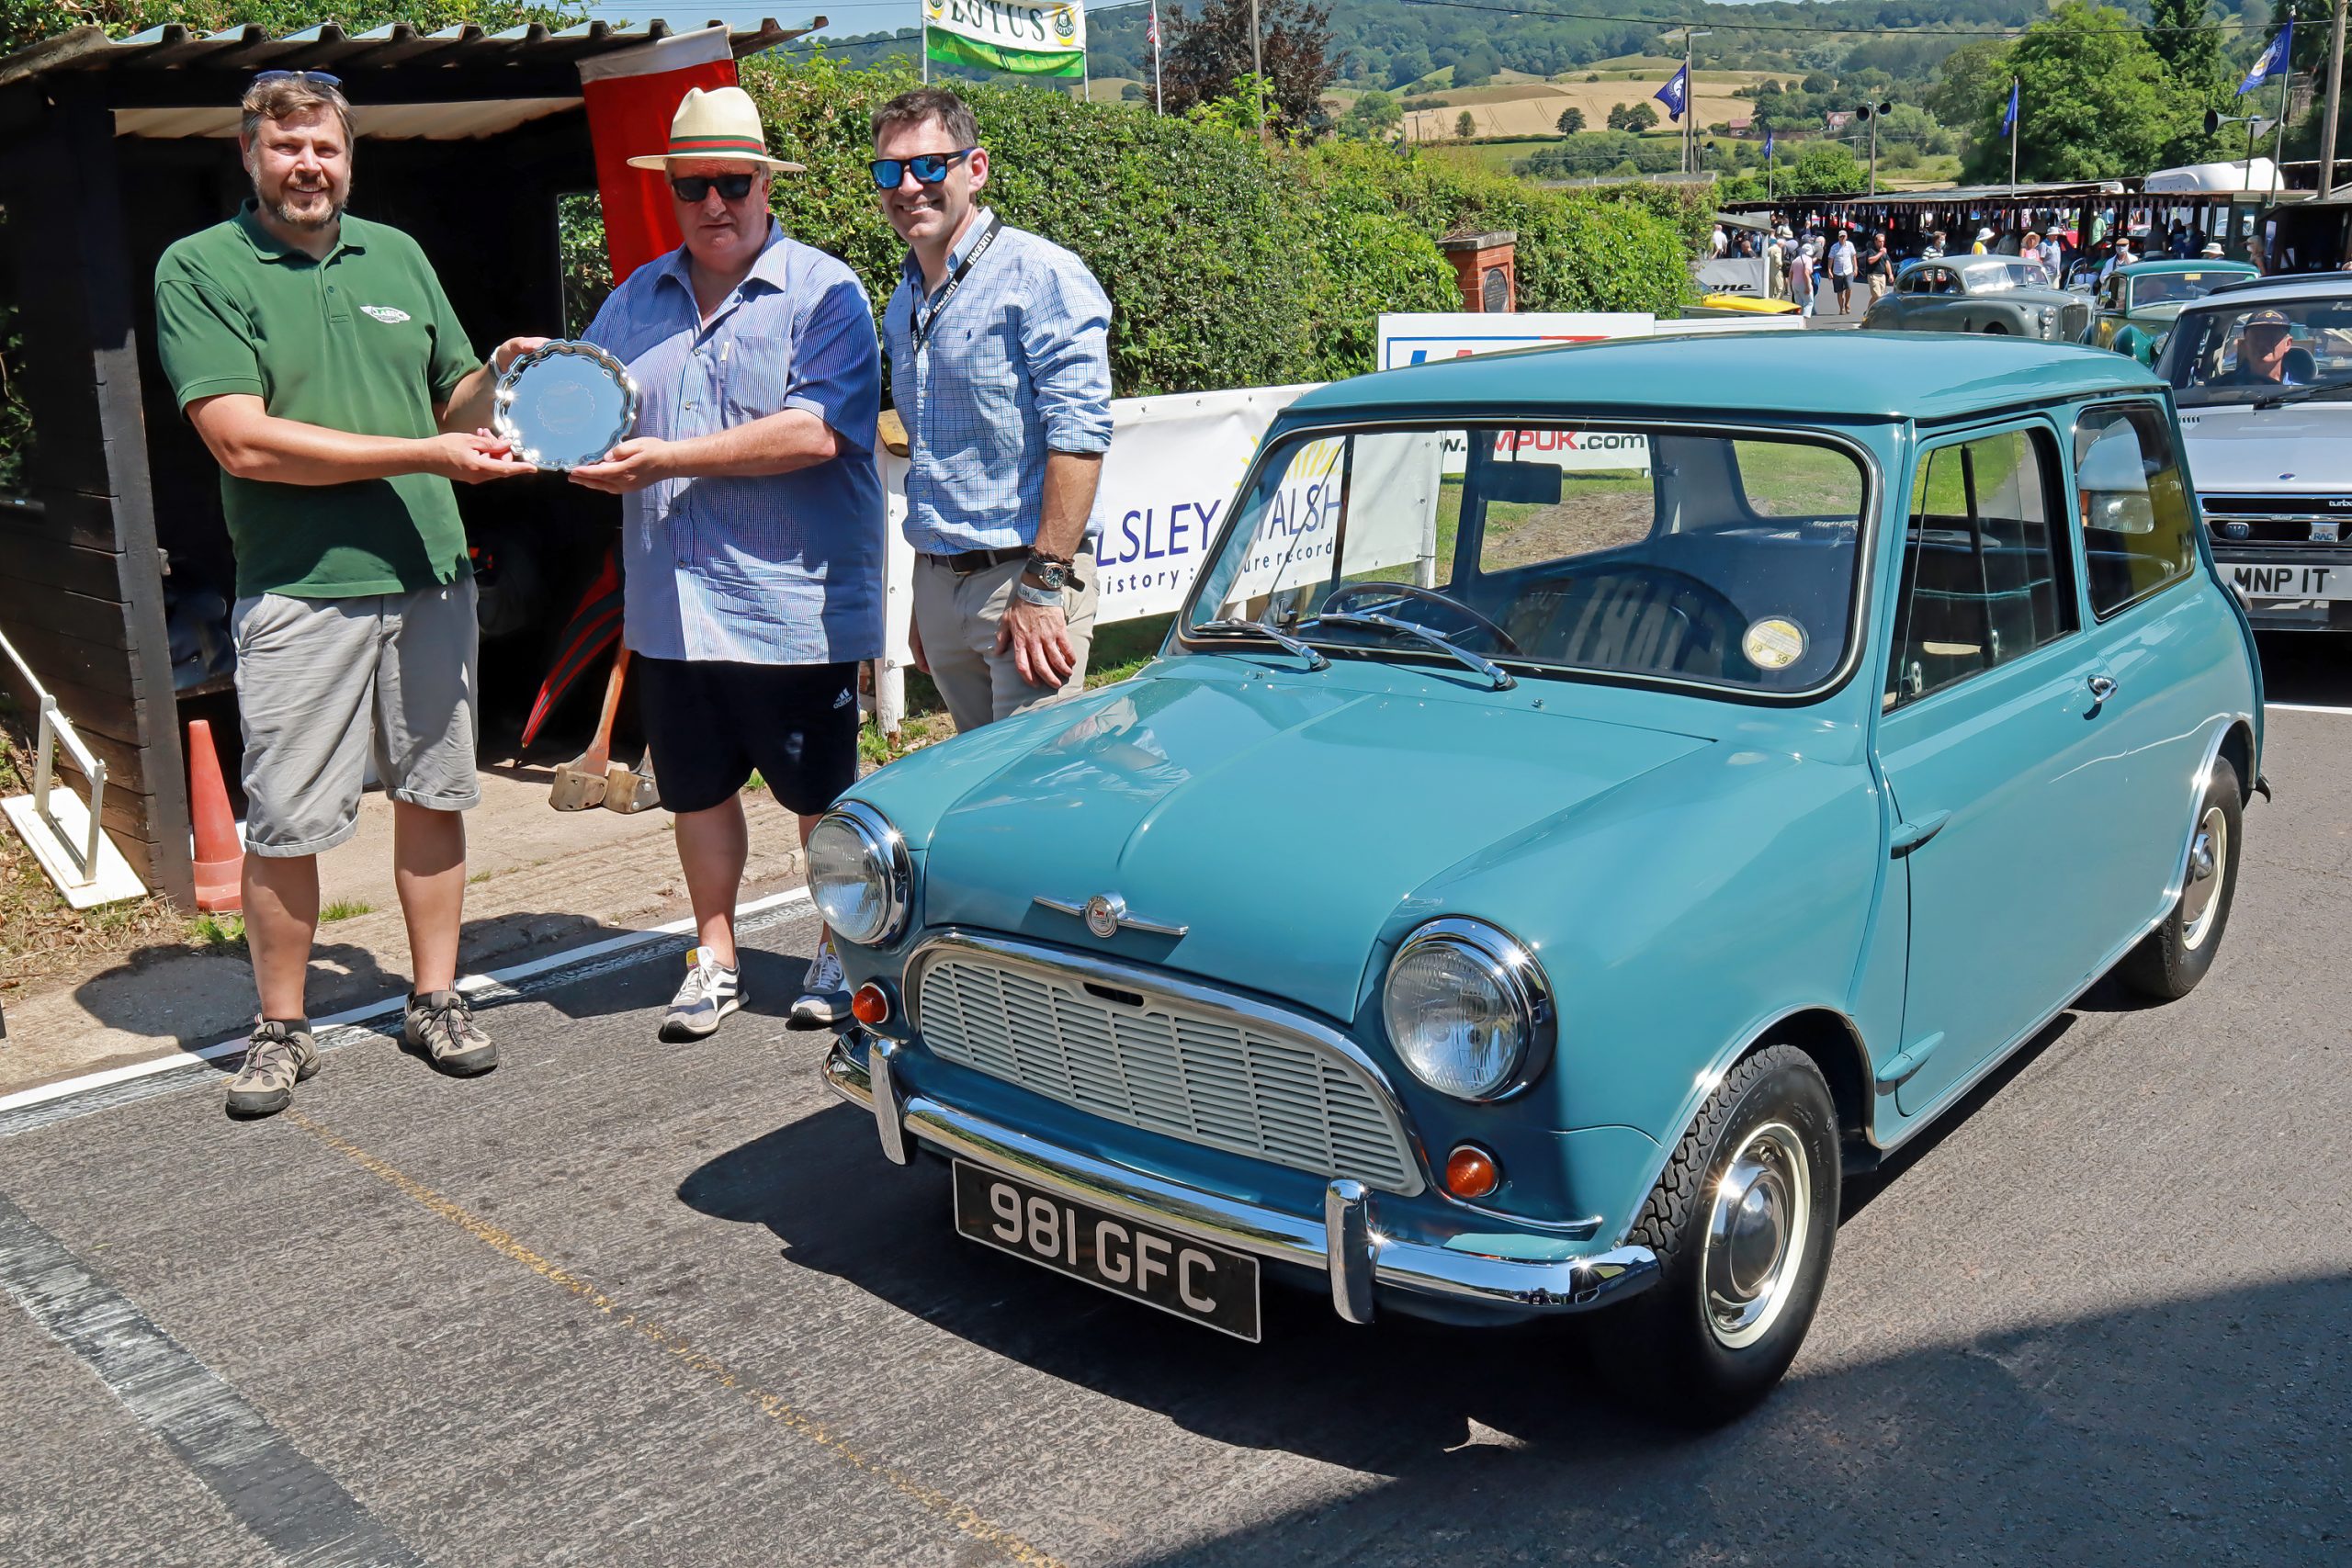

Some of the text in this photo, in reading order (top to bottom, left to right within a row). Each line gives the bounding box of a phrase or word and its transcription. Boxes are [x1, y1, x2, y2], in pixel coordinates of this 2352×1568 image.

[952, 0, 1045, 41] LOTUS
[1054, 23, 1074, 37] LOTUS
[967, 231, 993, 265] HAGERTY
[1258, 484, 1342, 542] ALSH
[1277, 536, 1333, 566] record
[2313, 532, 2334, 540] RAC
[2234, 567, 2293, 592] MNP
[1775, 653, 1789, 665] 59
[989, 1182, 1216, 1313] 981 GFC
